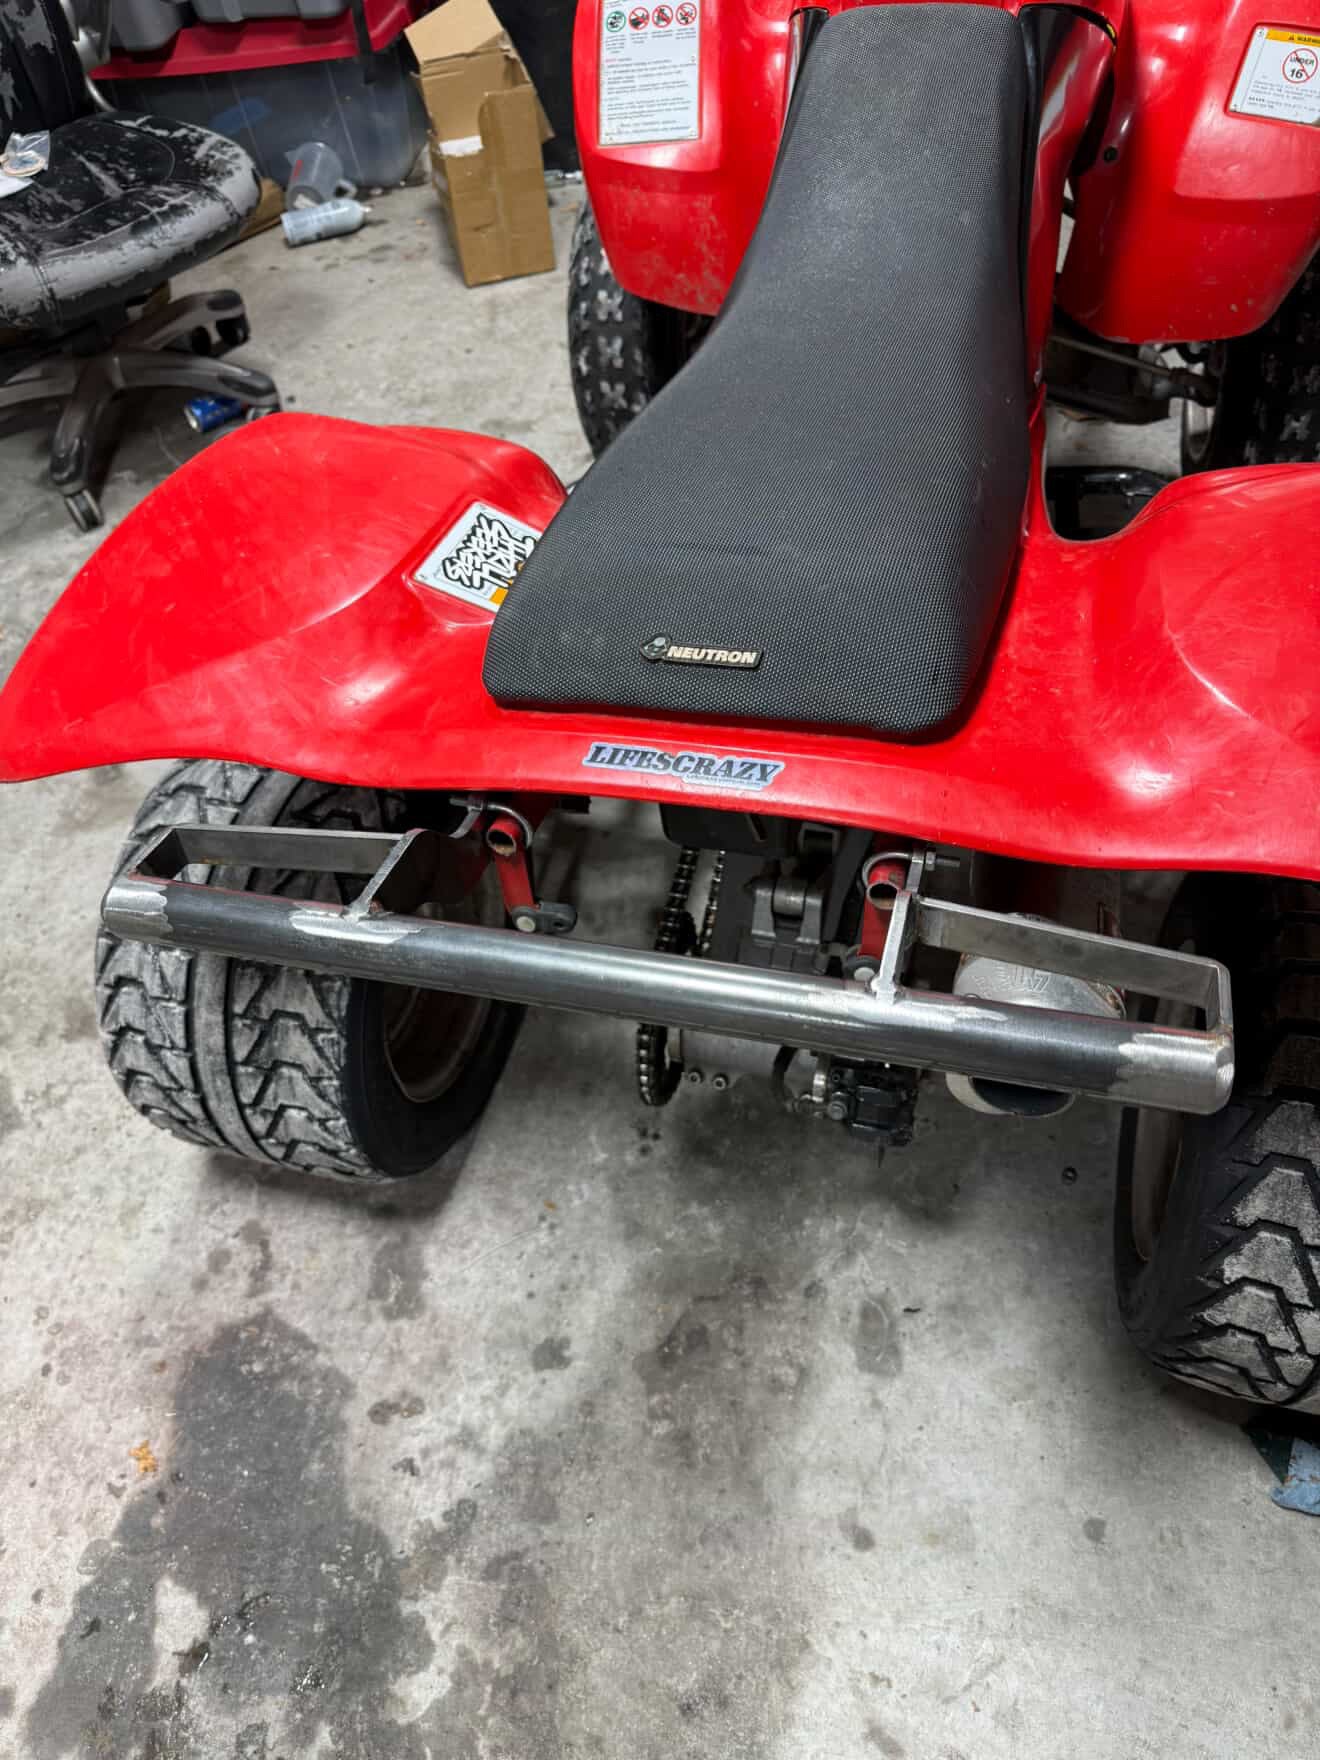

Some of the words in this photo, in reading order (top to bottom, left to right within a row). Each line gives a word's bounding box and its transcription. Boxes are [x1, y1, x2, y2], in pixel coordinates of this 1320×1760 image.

[1290, 69, 1304, 79] 16
[667, 645, 758, 665] NEUTRON
[587, 745, 780, 783] LIFESCRAZY
